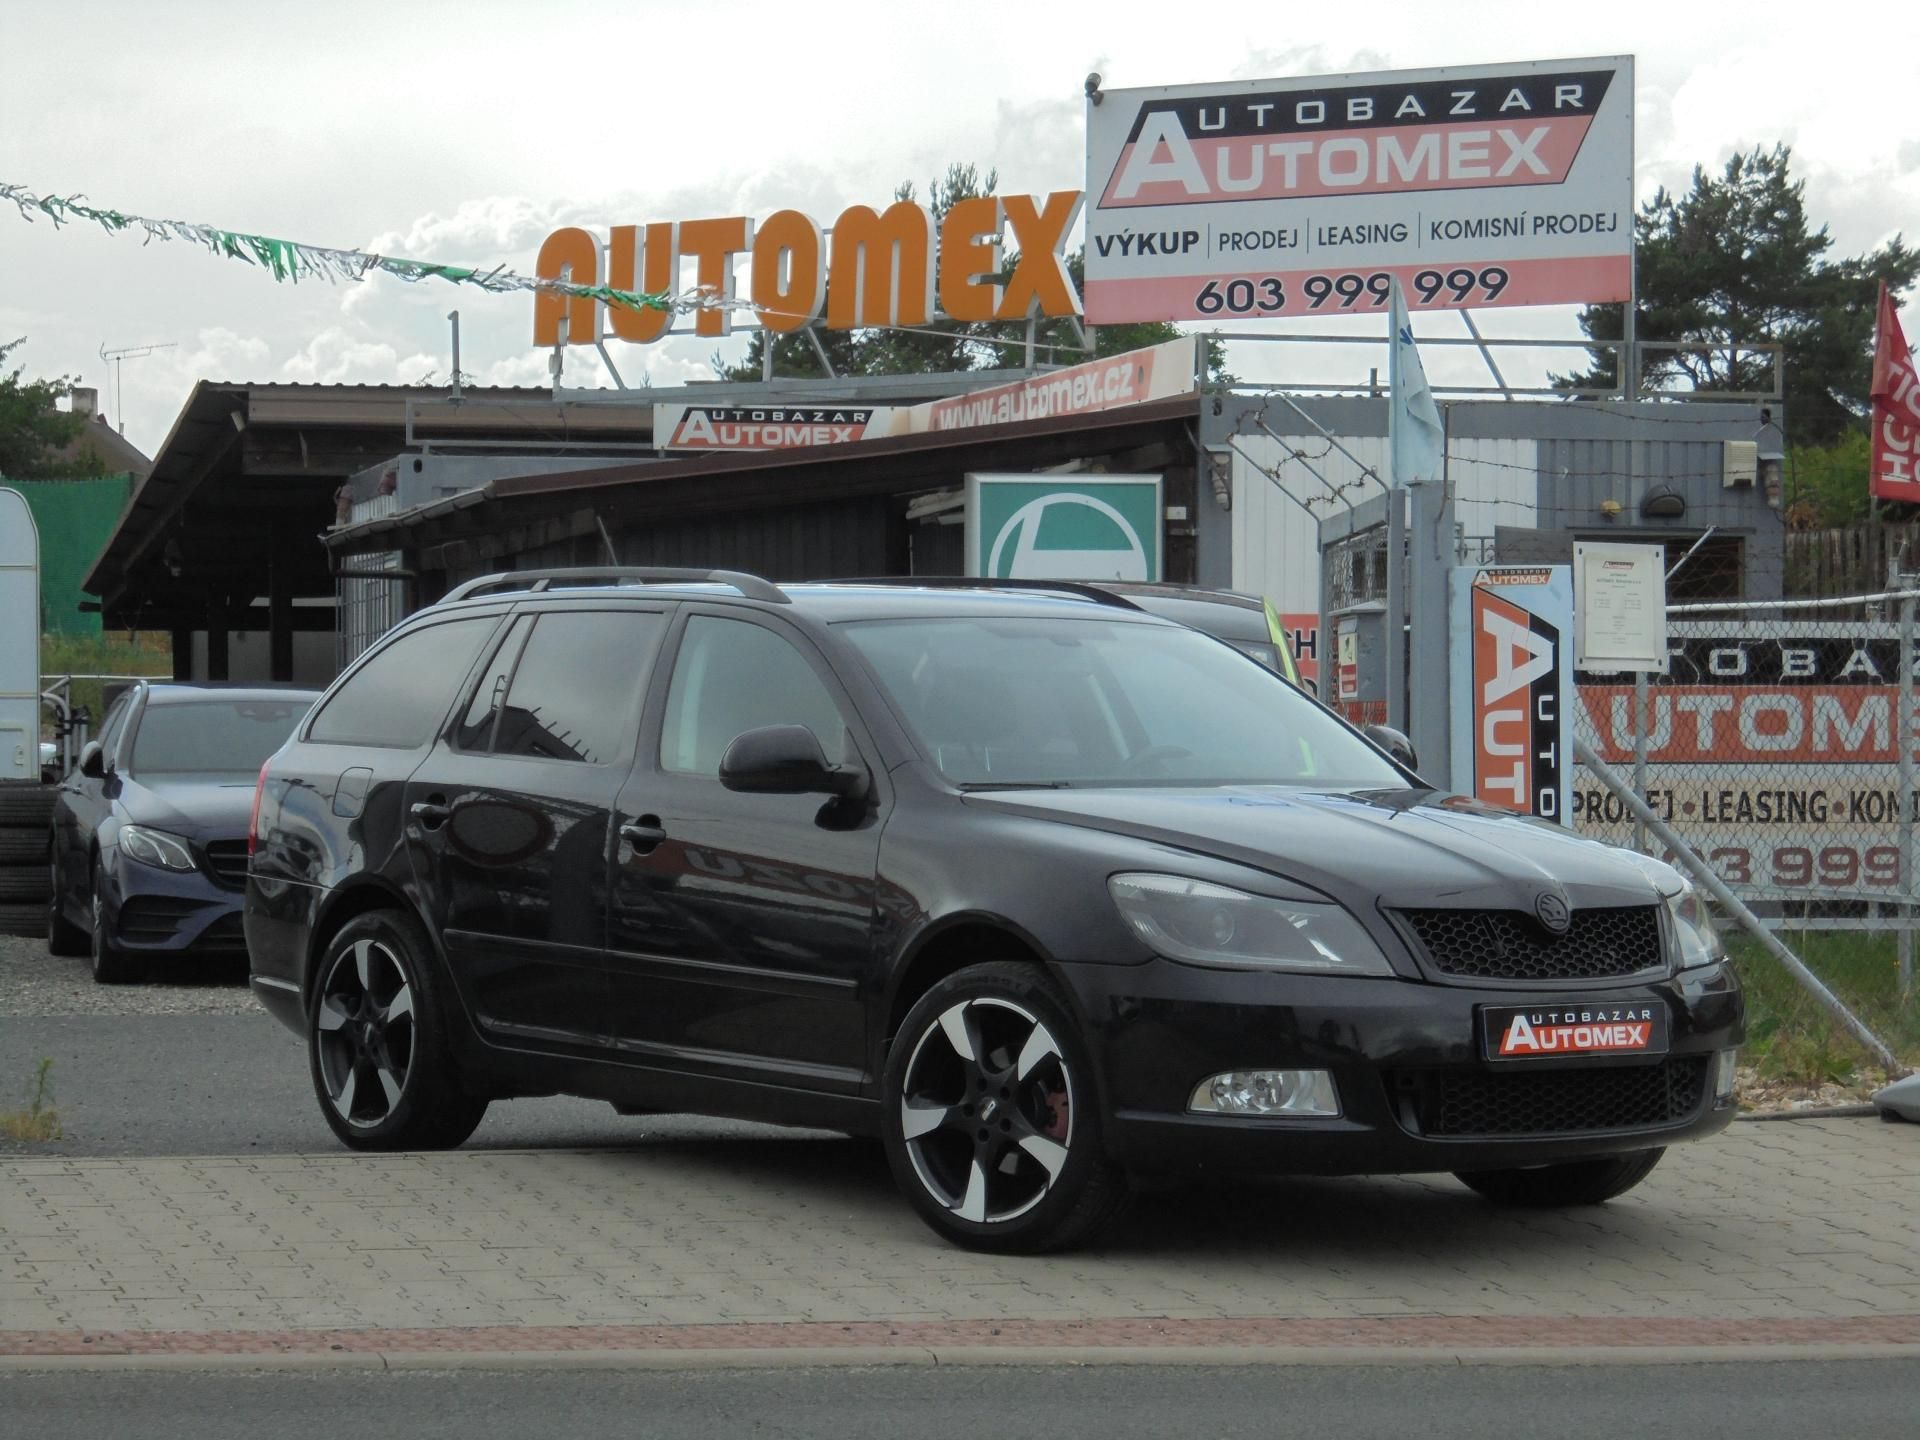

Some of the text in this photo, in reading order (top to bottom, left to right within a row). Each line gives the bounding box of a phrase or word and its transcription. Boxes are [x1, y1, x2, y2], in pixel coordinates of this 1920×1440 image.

[1113, 111, 1551, 198] AUTOMEX
[1095, 211, 1617, 257] VÝKUP PRODEJ LEASING KOMISNÍ PRODEJ
[533, 190, 1085, 347] AUTOMEX
[1196, 267, 1509, 314] 603 999 999
[940, 363, 1133, 430] www.automex.cz
[677, 411, 853, 446] AUTOMEX
[1475, 571, 1546, 585] AUTOMEX
[1703, 791, 1827, 824] LEASING
[1505, 1015, 1644, 1051] AUTOMEX
